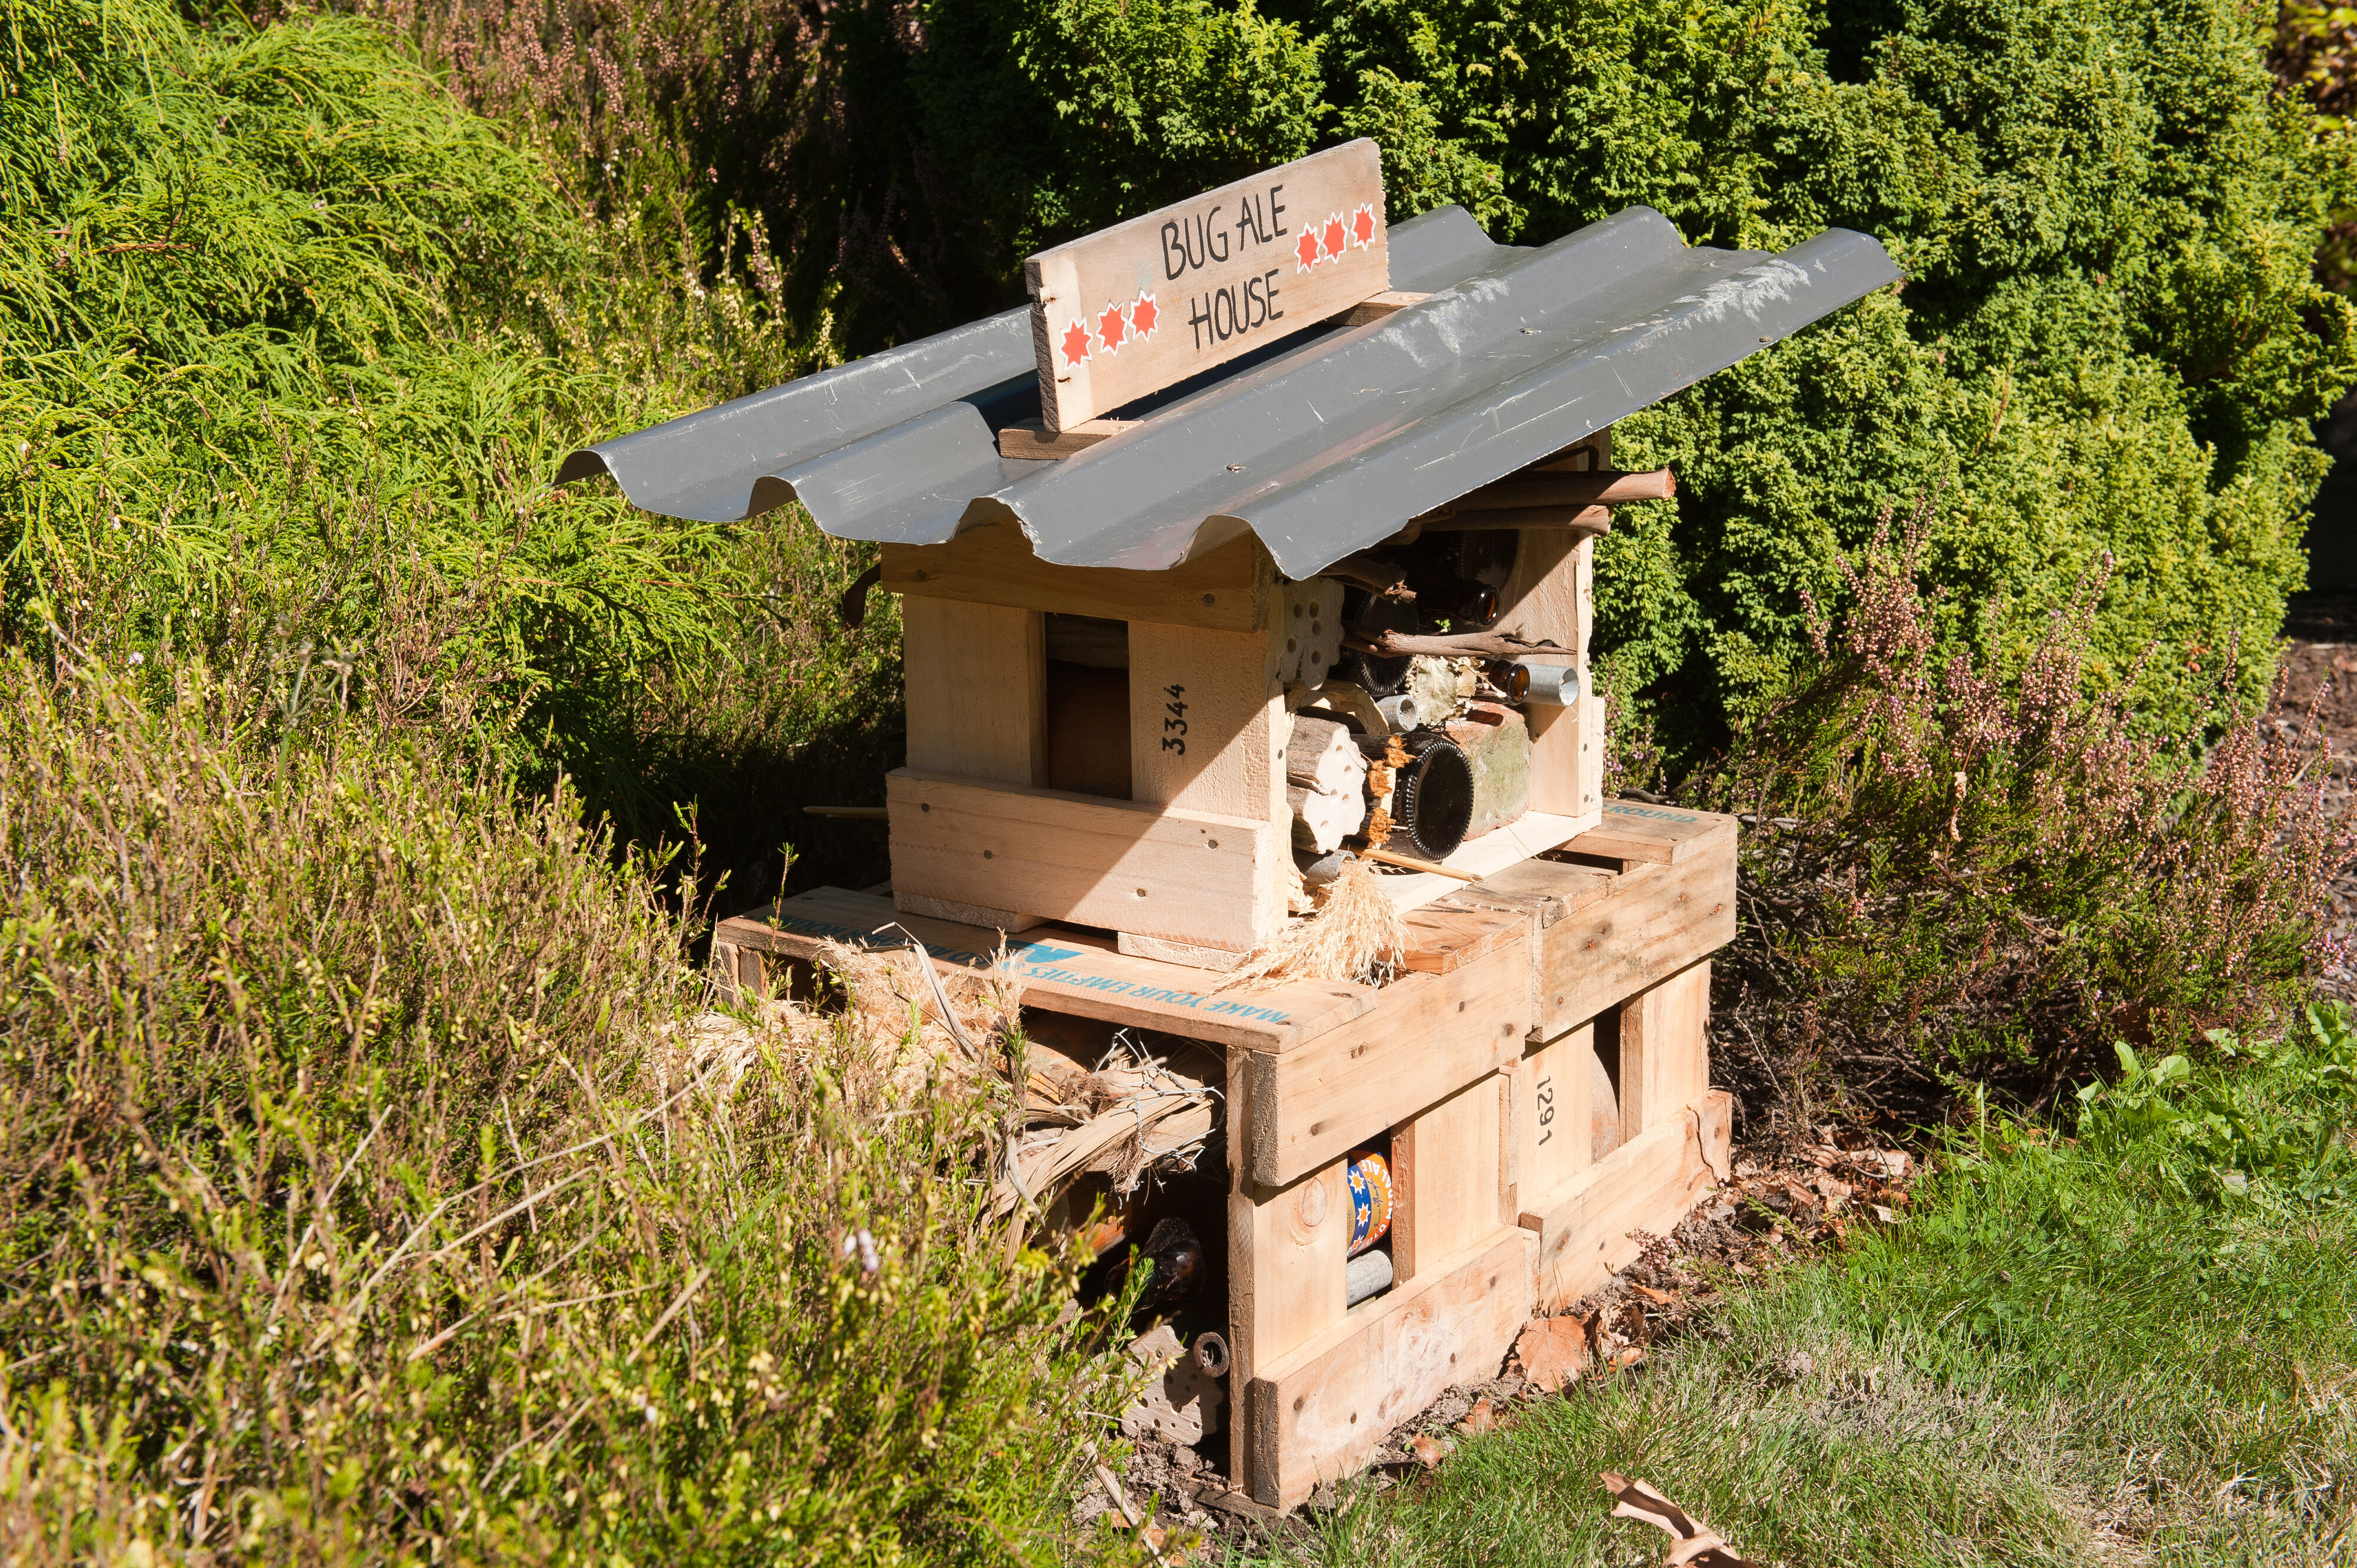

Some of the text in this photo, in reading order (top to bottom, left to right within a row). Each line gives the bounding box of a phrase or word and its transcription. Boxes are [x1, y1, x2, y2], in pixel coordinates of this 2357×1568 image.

[1161, 184, 1287, 280] BUG ALE
[1188, 268, 1284, 351] HOUSE
[1162, 684, 1188, 755] 3344
[1608, 806, 1697, 823] ROUND
[1129, 985, 1206, 1008] YOUR
[1203, 1000, 1291, 1022] MAKE
[1537, 1075, 1554, 1146] 1291
[1360, 1159, 1381, 1176] ALE
